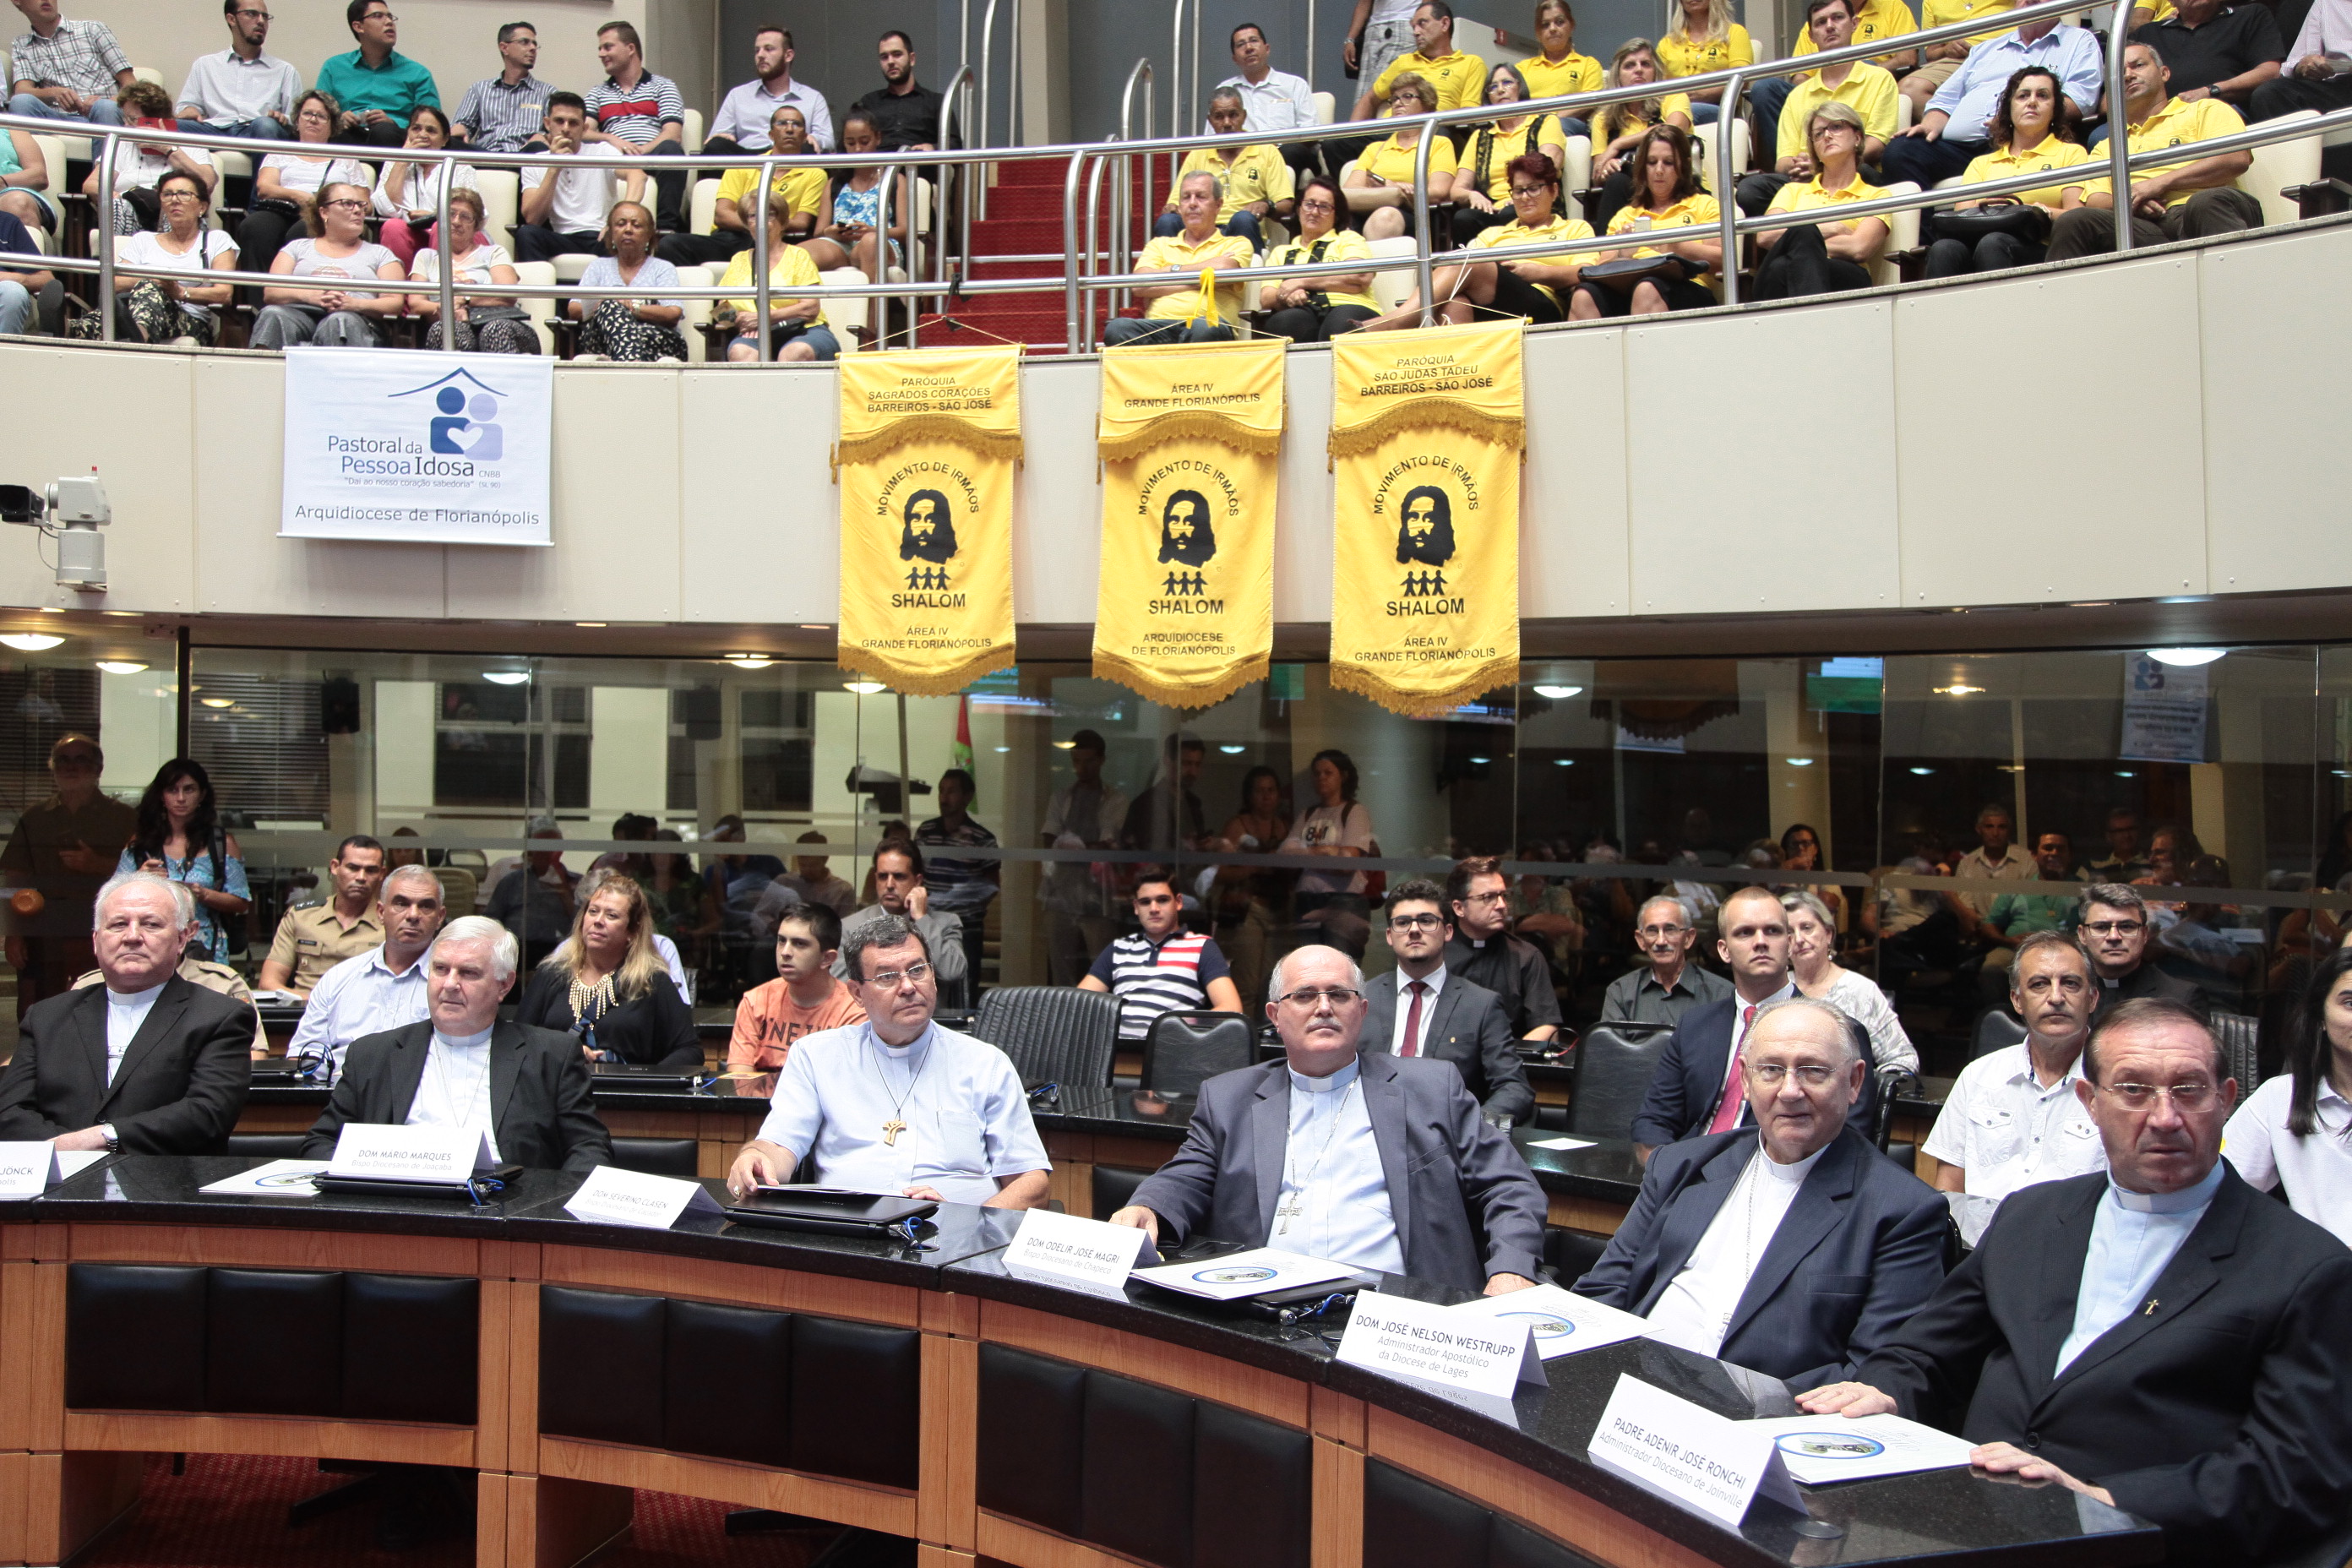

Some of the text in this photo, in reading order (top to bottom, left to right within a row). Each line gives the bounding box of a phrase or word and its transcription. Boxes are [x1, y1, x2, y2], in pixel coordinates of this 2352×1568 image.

[1396, 355, 1454, 367] PARÓQUIA
[1401, 368, 1437, 380] JUDAS
[1441, 365, 1478, 377] TADEU
[901, 376, 956, 386] PARÓQUIA
[1361, 383, 1424, 396] BARREIROS
[1462, 375, 1493, 389] JOSÉ
[868, 387, 990, 400] SAGRADOS CORAÇÕES
[1171, 384, 1214, 394] ÁREA IV
[868, 402, 929, 412] BARREIROS
[964, 398, 992, 410] JOSÉ
[1124, 393, 1260, 408] GRANDE FLORIANÓPOLIS
[327, 435, 422, 454] Pastoral da
[342, 455, 411, 474] Pessoa
[415, 456, 474, 476] Idosa
[400, 479, 430, 487] coração
[878, 461, 979, 515] MOVIMENTO DE IRMÃOS
[1138, 460, 1239, 516] MOVIMENTO DE IRMÃOS
[1374, 455, 1478, 514] MOVIMENTO DE IRMÃOS
[295, 505, 539, 526] Arquidiocese de Florianópolis
[891, 593, 966, 607] SHALOM
[1149, 599, 1223, 614] SHALOM
[1386, 598, 1464, 616] SHALOM
[906, 625, 949, 635] ÁREA IV
[862, 638, 992, 649] GRANDE FLORIANÓPOLIS
[1143, 633, 1223, 643] ARQUIDIOCESE
[1404, 636, 1447, 647] ÁREA IV
[1132, 645, 1235, 656] DE FLORIANÓPOLIS
[1355, 648, 1495, 662] GRANDE FLORIANÓPOLIS
[358, 1149, 451, 1161] DOM MÁRIO MARQUES
[351, 1160, 370, 1169] Bispo
[373, 1160, 409, 1169] Diocesano
[422, 1162, 452, 1172] Joaçaba
[592, 1190, 668, 1208] DOM SEVERINO CLASEN
[1027, 1237, 1120, 1264] DOM ODELIR JOSÉ MAGRI
[1024, 1249, 1040, 1260] Bispo
[1041, 1252, 1073, 1266] Diocesano
[1074, 1260, 1082, 1268] de
[1356, 1315, 1515, 1358] DOM JOSÉ NELSON WESTRUPP
[1378, 1336, 1489, 1368] Administrador Apostólico
[1379, 1350, 1468, 1378] da Diocese de Lages
[1614, 1418, 1746, 1489] PADRE ADENIR JOSÉ RONCHI
[1598, 1431, 1743, 1509] Administrador Diocesano de Joinville
